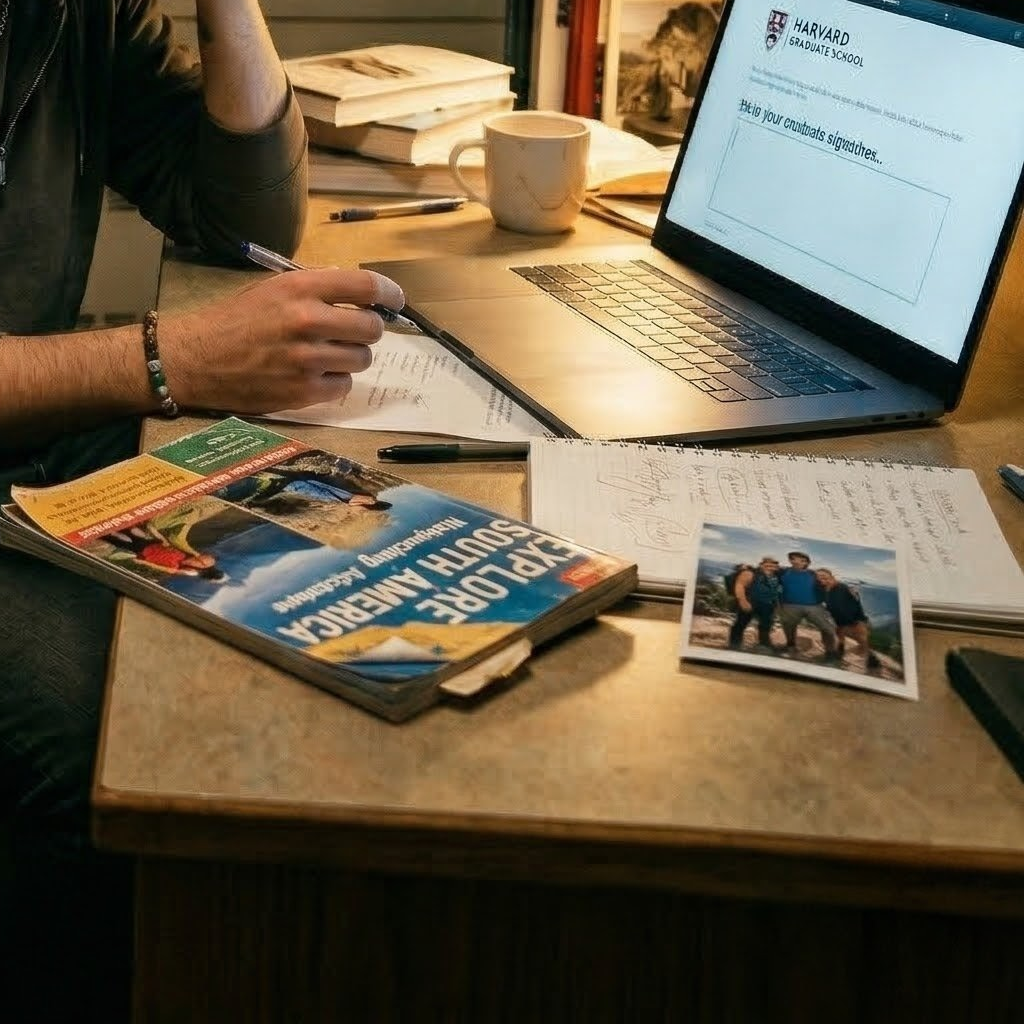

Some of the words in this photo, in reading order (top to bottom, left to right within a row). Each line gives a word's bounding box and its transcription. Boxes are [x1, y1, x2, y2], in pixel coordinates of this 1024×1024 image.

[789, 36, 830, 57] GRADUATE
[830, 48, 864, 67] SCHOOL
[793, 17, 850, 46] HARVARD
[762, 107, 783, 125] your
[416, 519, 529, 576] SOUTH
[415, 530, 576, 624] EXPLORE
[277, 567, 433, 644] AMERICA
